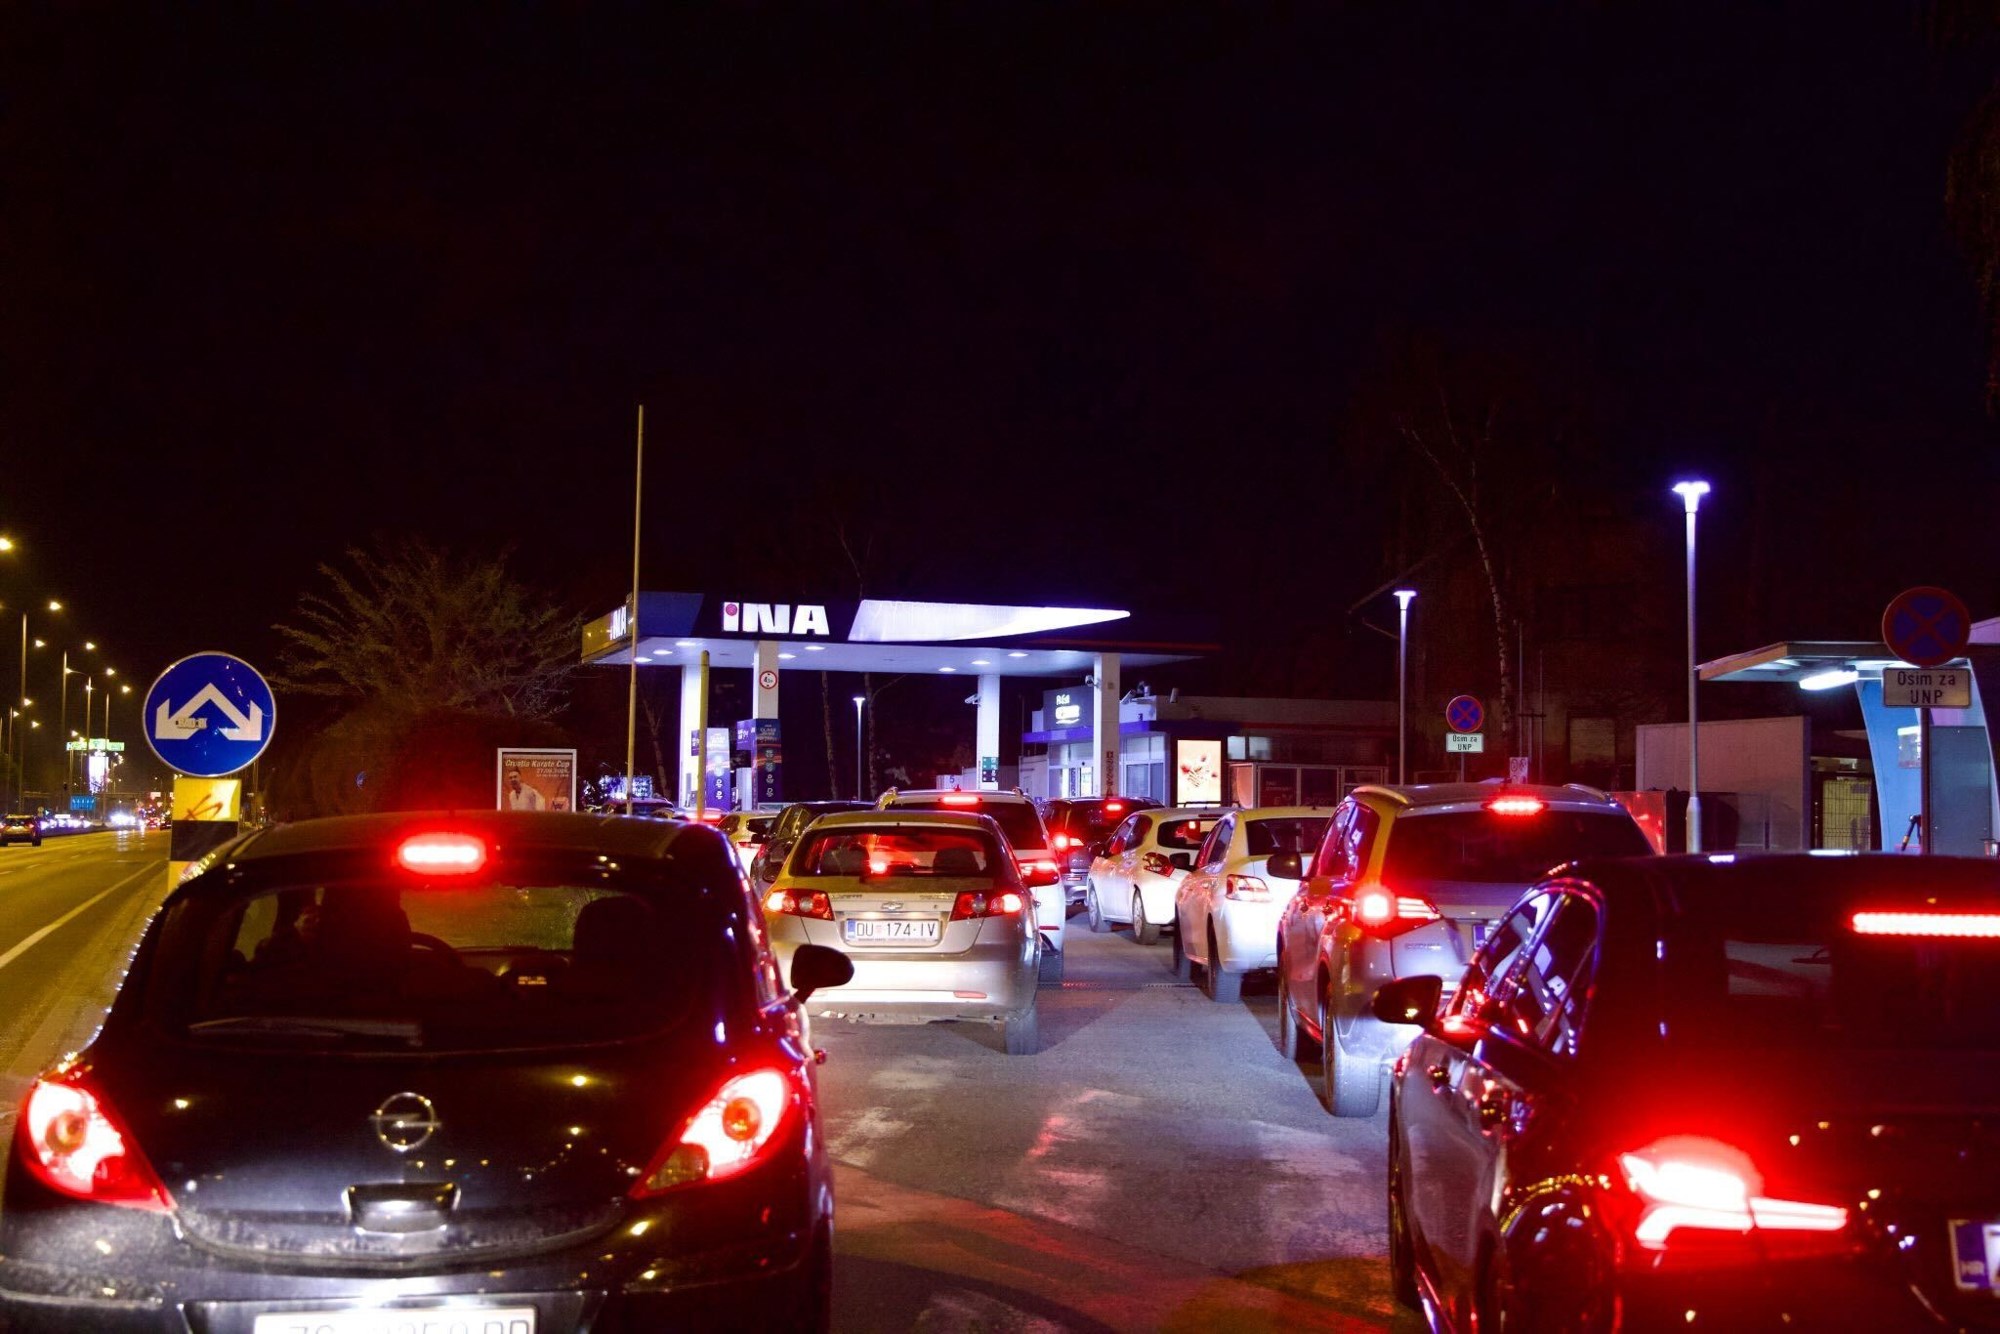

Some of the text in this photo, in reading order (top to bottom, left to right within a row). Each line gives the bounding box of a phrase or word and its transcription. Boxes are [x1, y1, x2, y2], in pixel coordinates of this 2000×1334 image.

[724, 602, 830, 635] INA
[1897, 671, 1956, 686] Osim za
[1910, 689, 1943, 704] UNP
[531, 759, 555, 768] Karate
[556, 760, 570, 769] Cup
[856, 922, 874, 937] DU
